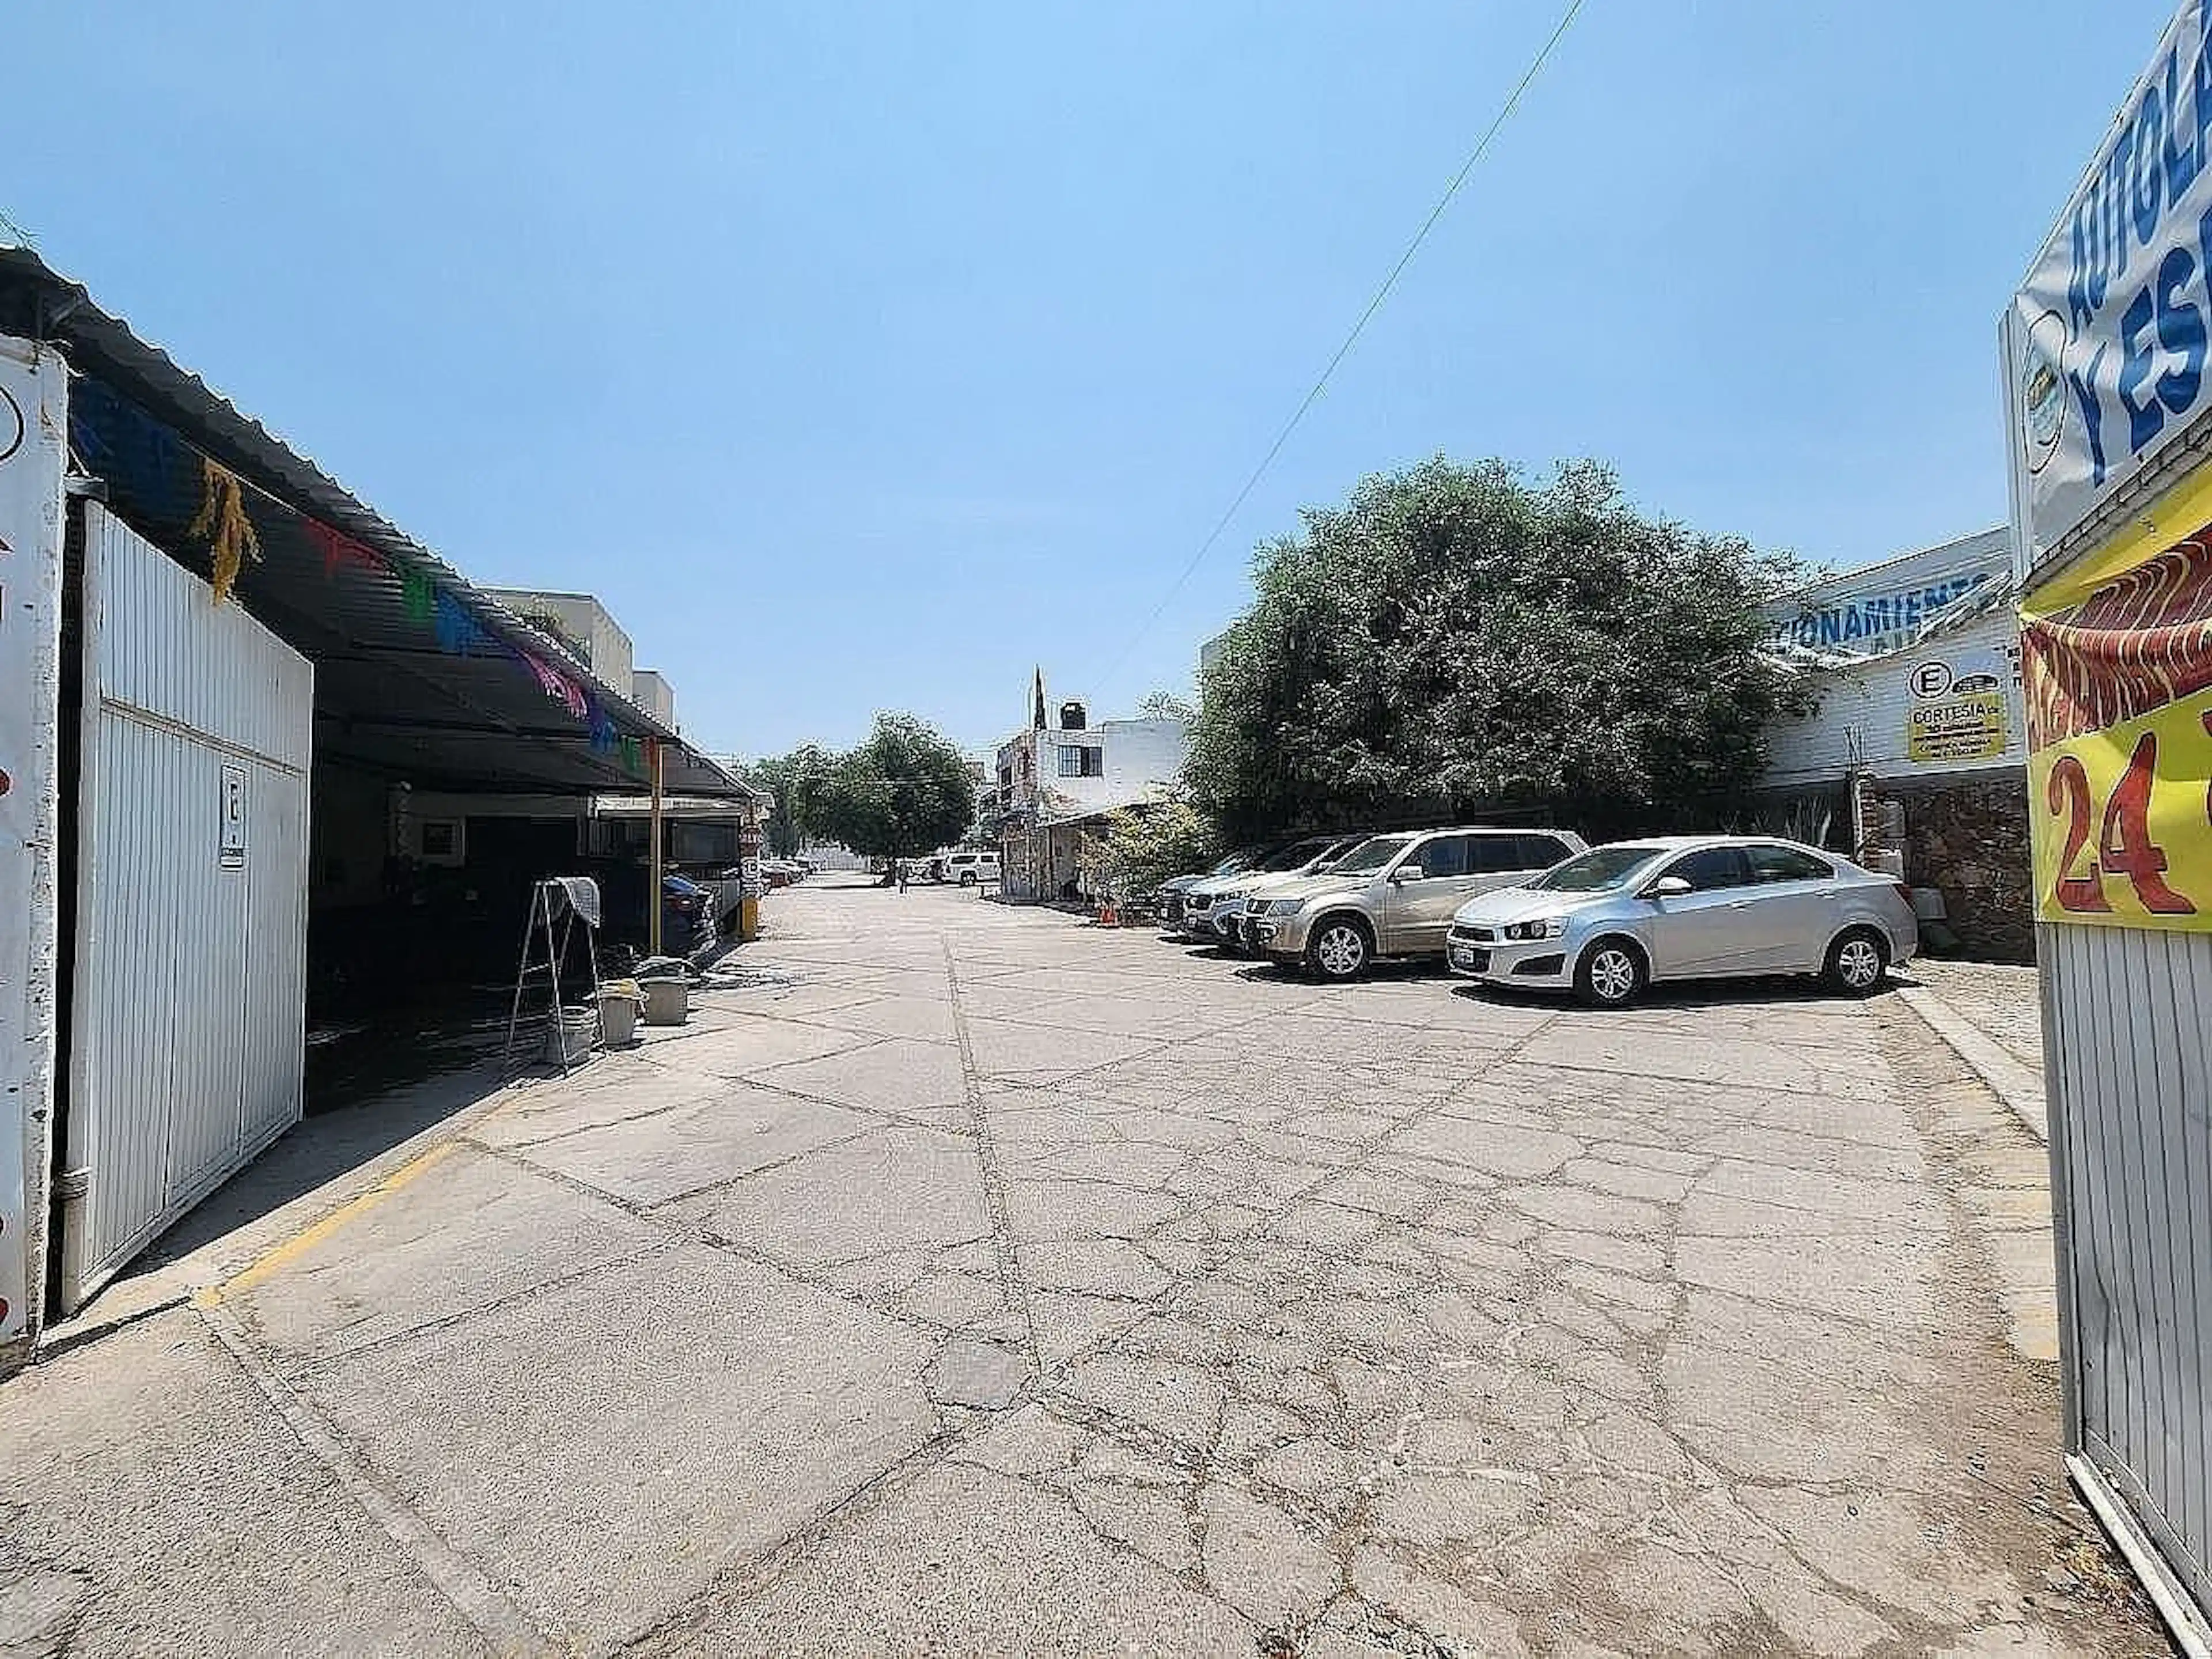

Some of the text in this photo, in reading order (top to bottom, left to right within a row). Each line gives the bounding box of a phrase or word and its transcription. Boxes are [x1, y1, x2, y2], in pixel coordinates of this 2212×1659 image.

[2070, 340, 2108, 487] Y
[1921, 668, 1941, 692] E
[2050, 730, 2197, 914] 24
